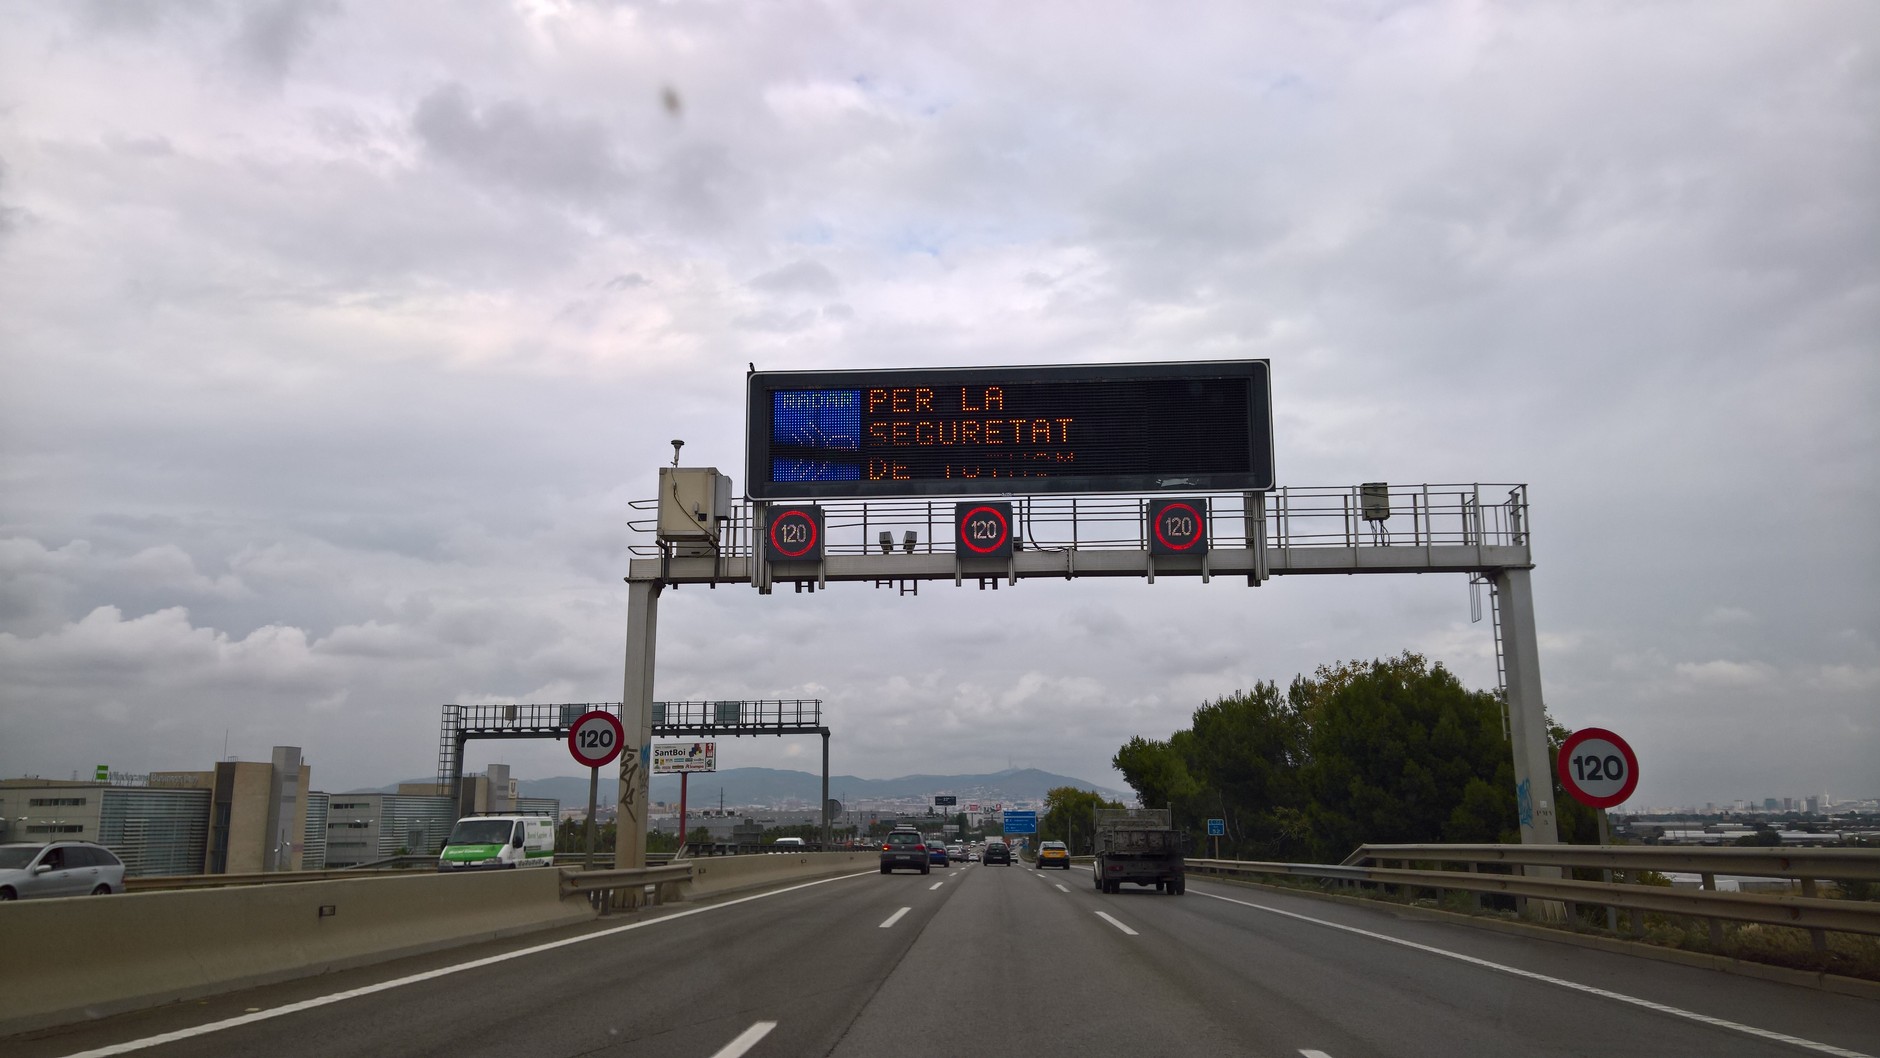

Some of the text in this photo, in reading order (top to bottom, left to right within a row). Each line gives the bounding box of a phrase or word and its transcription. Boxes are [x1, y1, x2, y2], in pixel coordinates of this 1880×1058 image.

[869, 387, 1003, 413] PER LA
[869, 418, 1073, 446] SEGURETAT
[781, 524, 807, 543] 120
[971, 520, 997, 539] 120
[1165, 516, 1192, 536] 120
[579, 729, 613, 748] 120
[654, 748, 686, 757] SantBoi
[1573, 755, 1624, 781] 120
